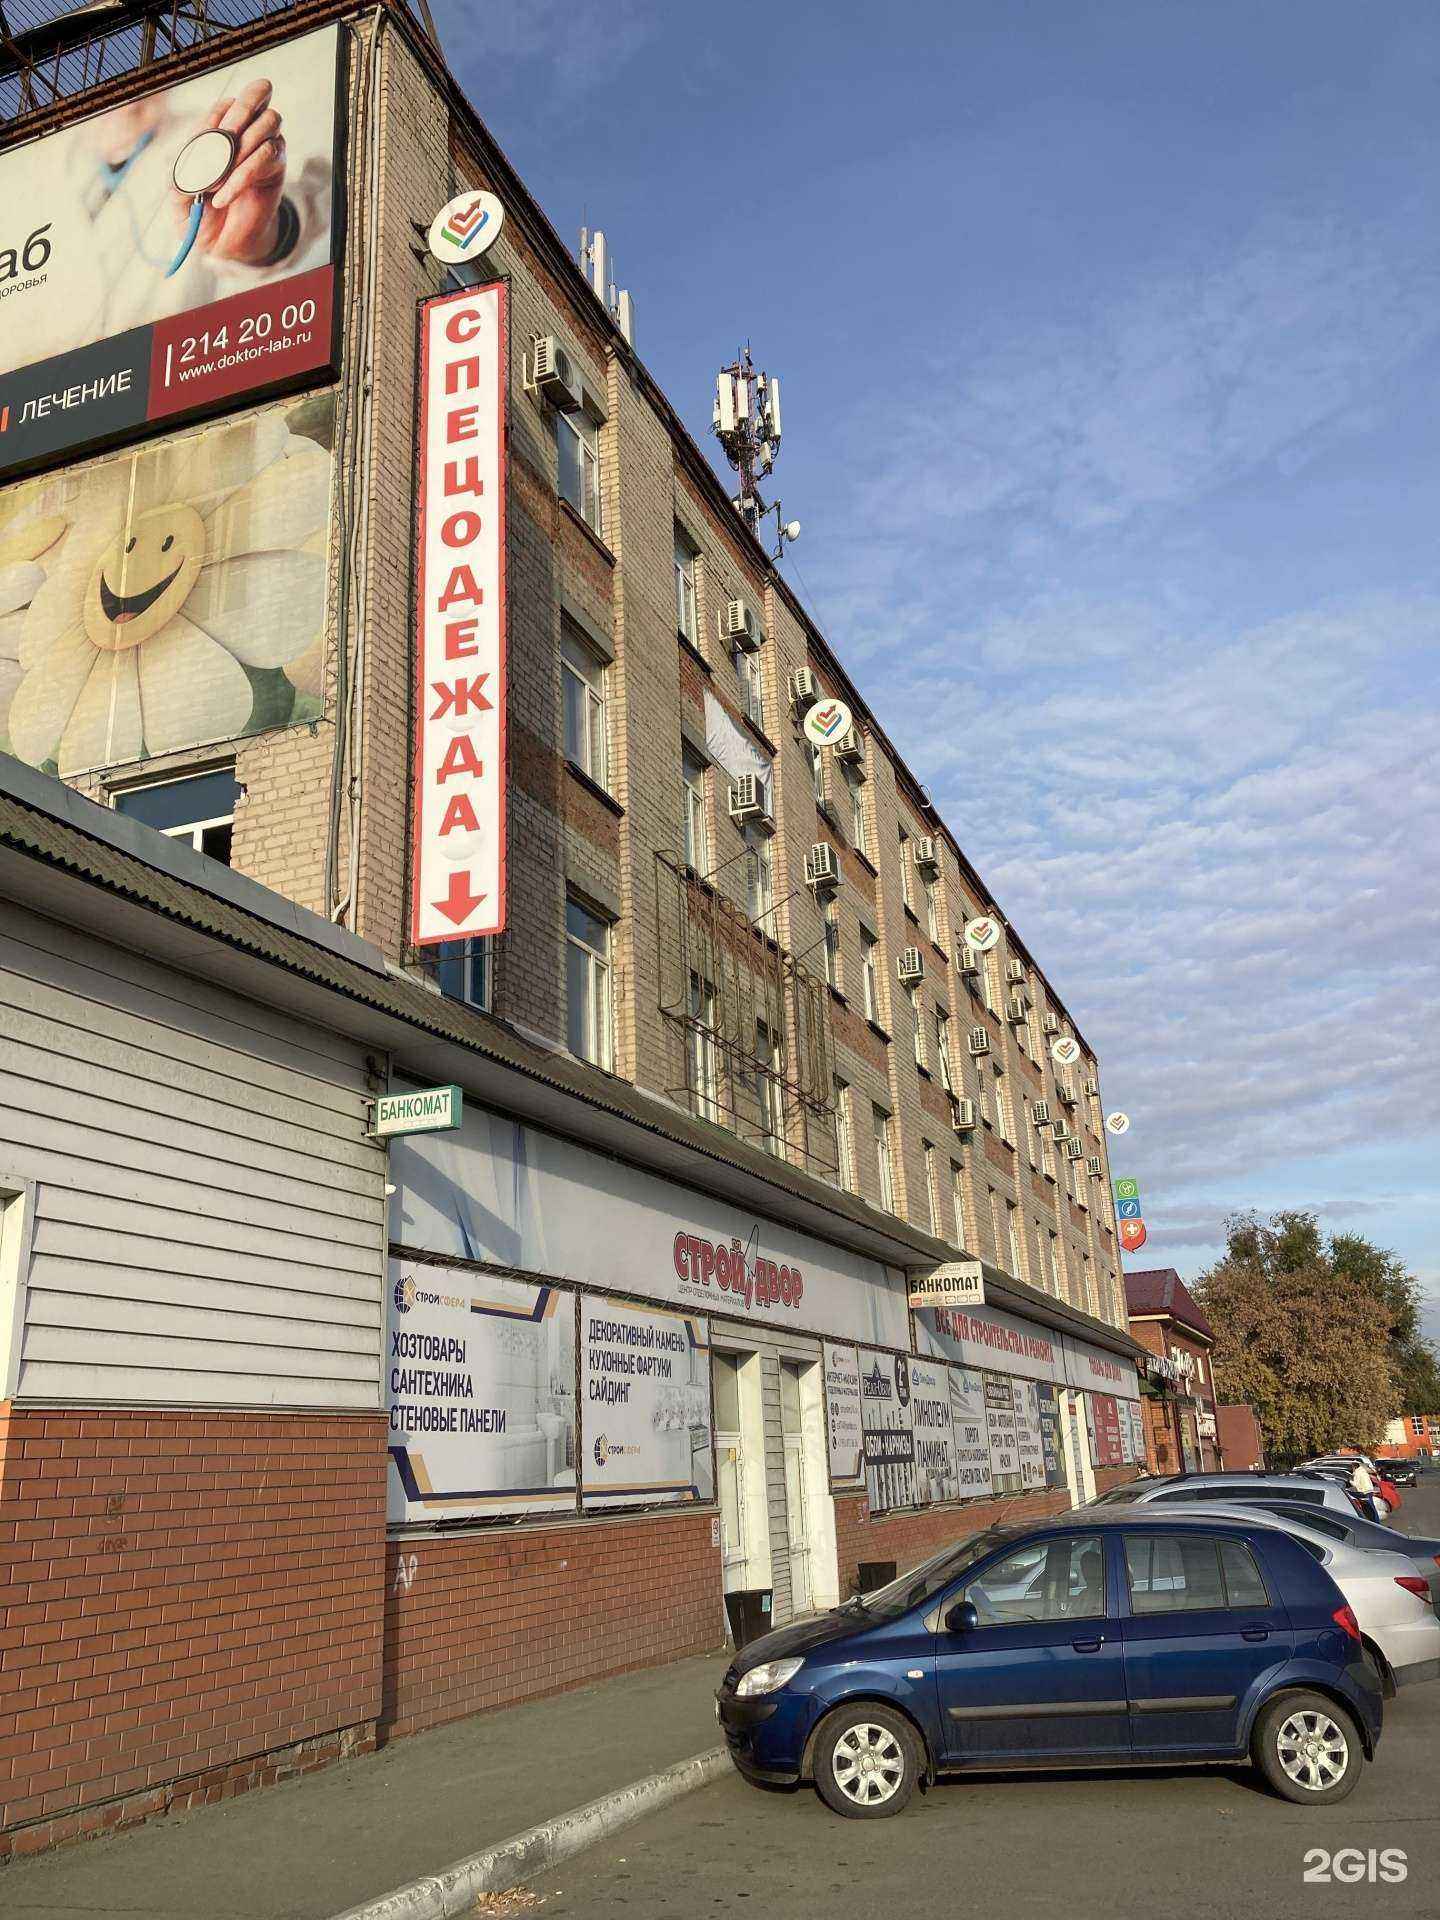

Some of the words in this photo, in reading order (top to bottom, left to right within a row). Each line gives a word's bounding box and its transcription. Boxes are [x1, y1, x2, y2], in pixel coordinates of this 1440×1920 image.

[180, 326, 228, 362] 214
[238, 313, 272, 344] 20
[281, 299, 316, 329] 00
[179, 331, 312, 382] www.doktor-lab.ru
[19, 369, 133, 424] ЛЕЧЕНИЕ
[429, 309, 495, 836] СПЕЦОДЕЖДА
[380, 1093, 450, 1121] БАНКОМАТ
[673, 1231, 746, 1296] СТРОЙ
[754, 1256, 804, 1308] ДВОР
[910, 1276, 979, 1294] БАНКОМАТ
[391, 1331, 466, 1364] ХОЗТОВАРЫ
[588, 1318, 655, 1349] ДЕКОРАТИВНЫЙ
[655, 1329, 685, 1353] КАМЕНЬ
[951, 1311, 969, 1343] ДЛЯ
[970, 1318, 1024, 1356] СТРОИТЕЛЬСТВА
[589, 1349, 636, 1375] КУХОННЫЕ
[636, 1355, 672, 1378] ФАРТУКИ
[391, 1367, 474, 1399] САНТЕХНИКА
[589, 1376, 631, 1406] САЙДИНГ
[390, 1404, 458, 1433] СТЕНОВЫЕ
[460, 1407, 506, 1434] ПАНЕЛИ
[913, 1398, 951, 1428] ЛИНОЛЕУМ
[917, 1439, 949, 1468] ЛАМИНАТ
